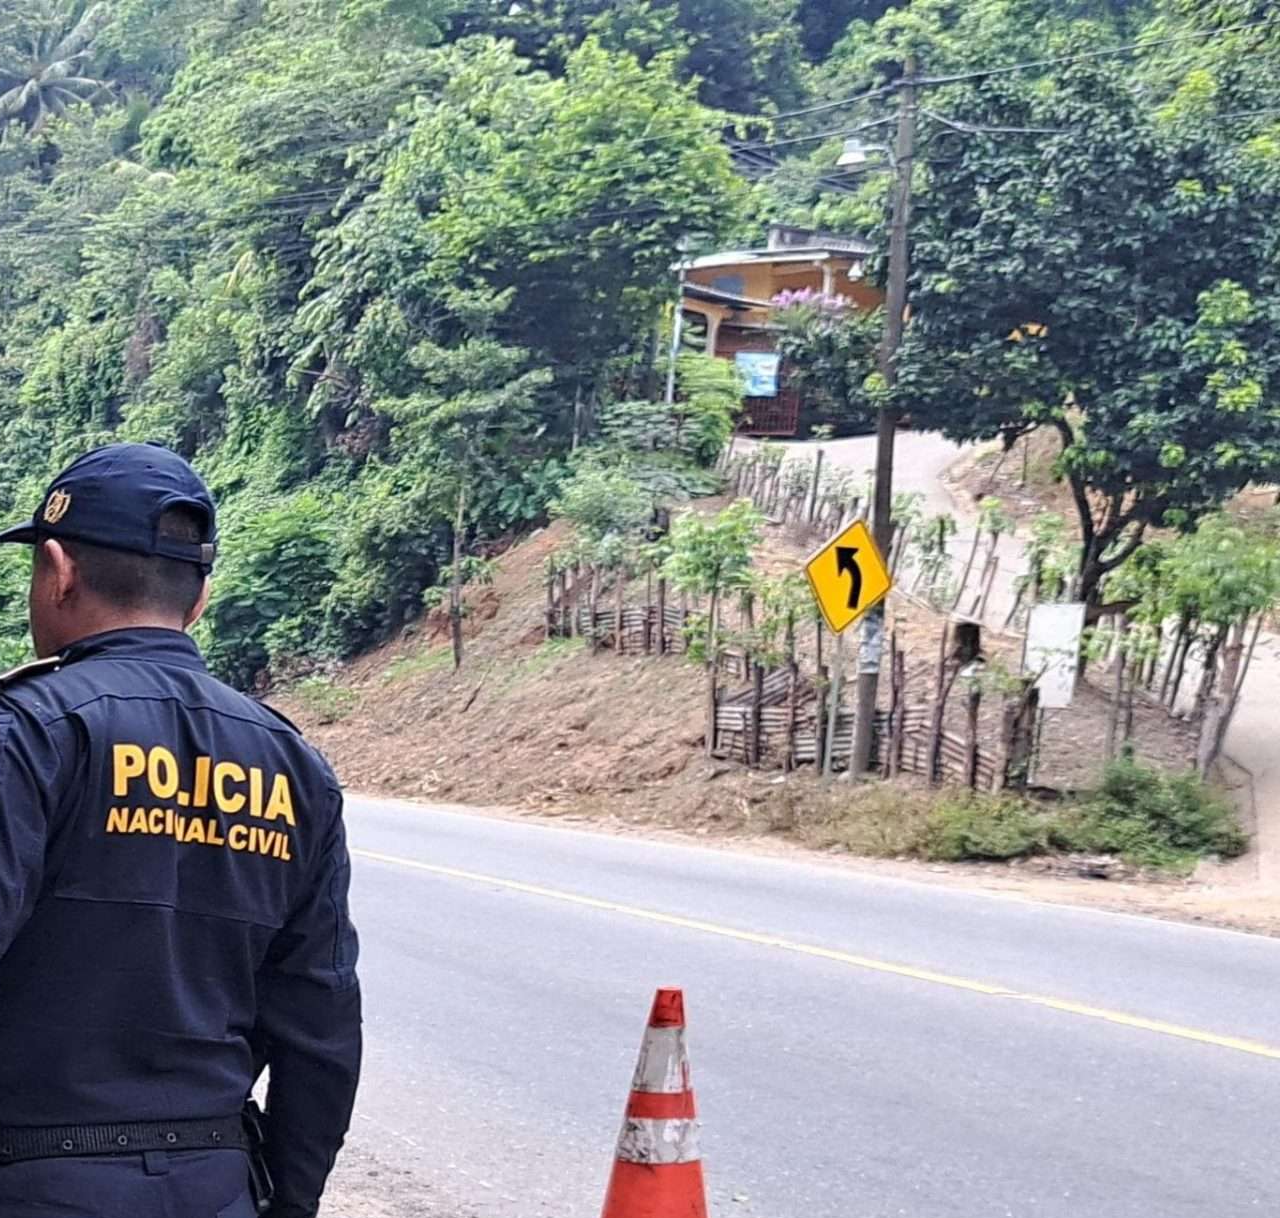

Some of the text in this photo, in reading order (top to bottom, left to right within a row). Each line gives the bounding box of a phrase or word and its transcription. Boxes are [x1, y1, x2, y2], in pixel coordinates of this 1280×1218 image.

[112, 743, 297, 828] POICIA
[106, 807, 292, 862] NACINAL CIVIL
